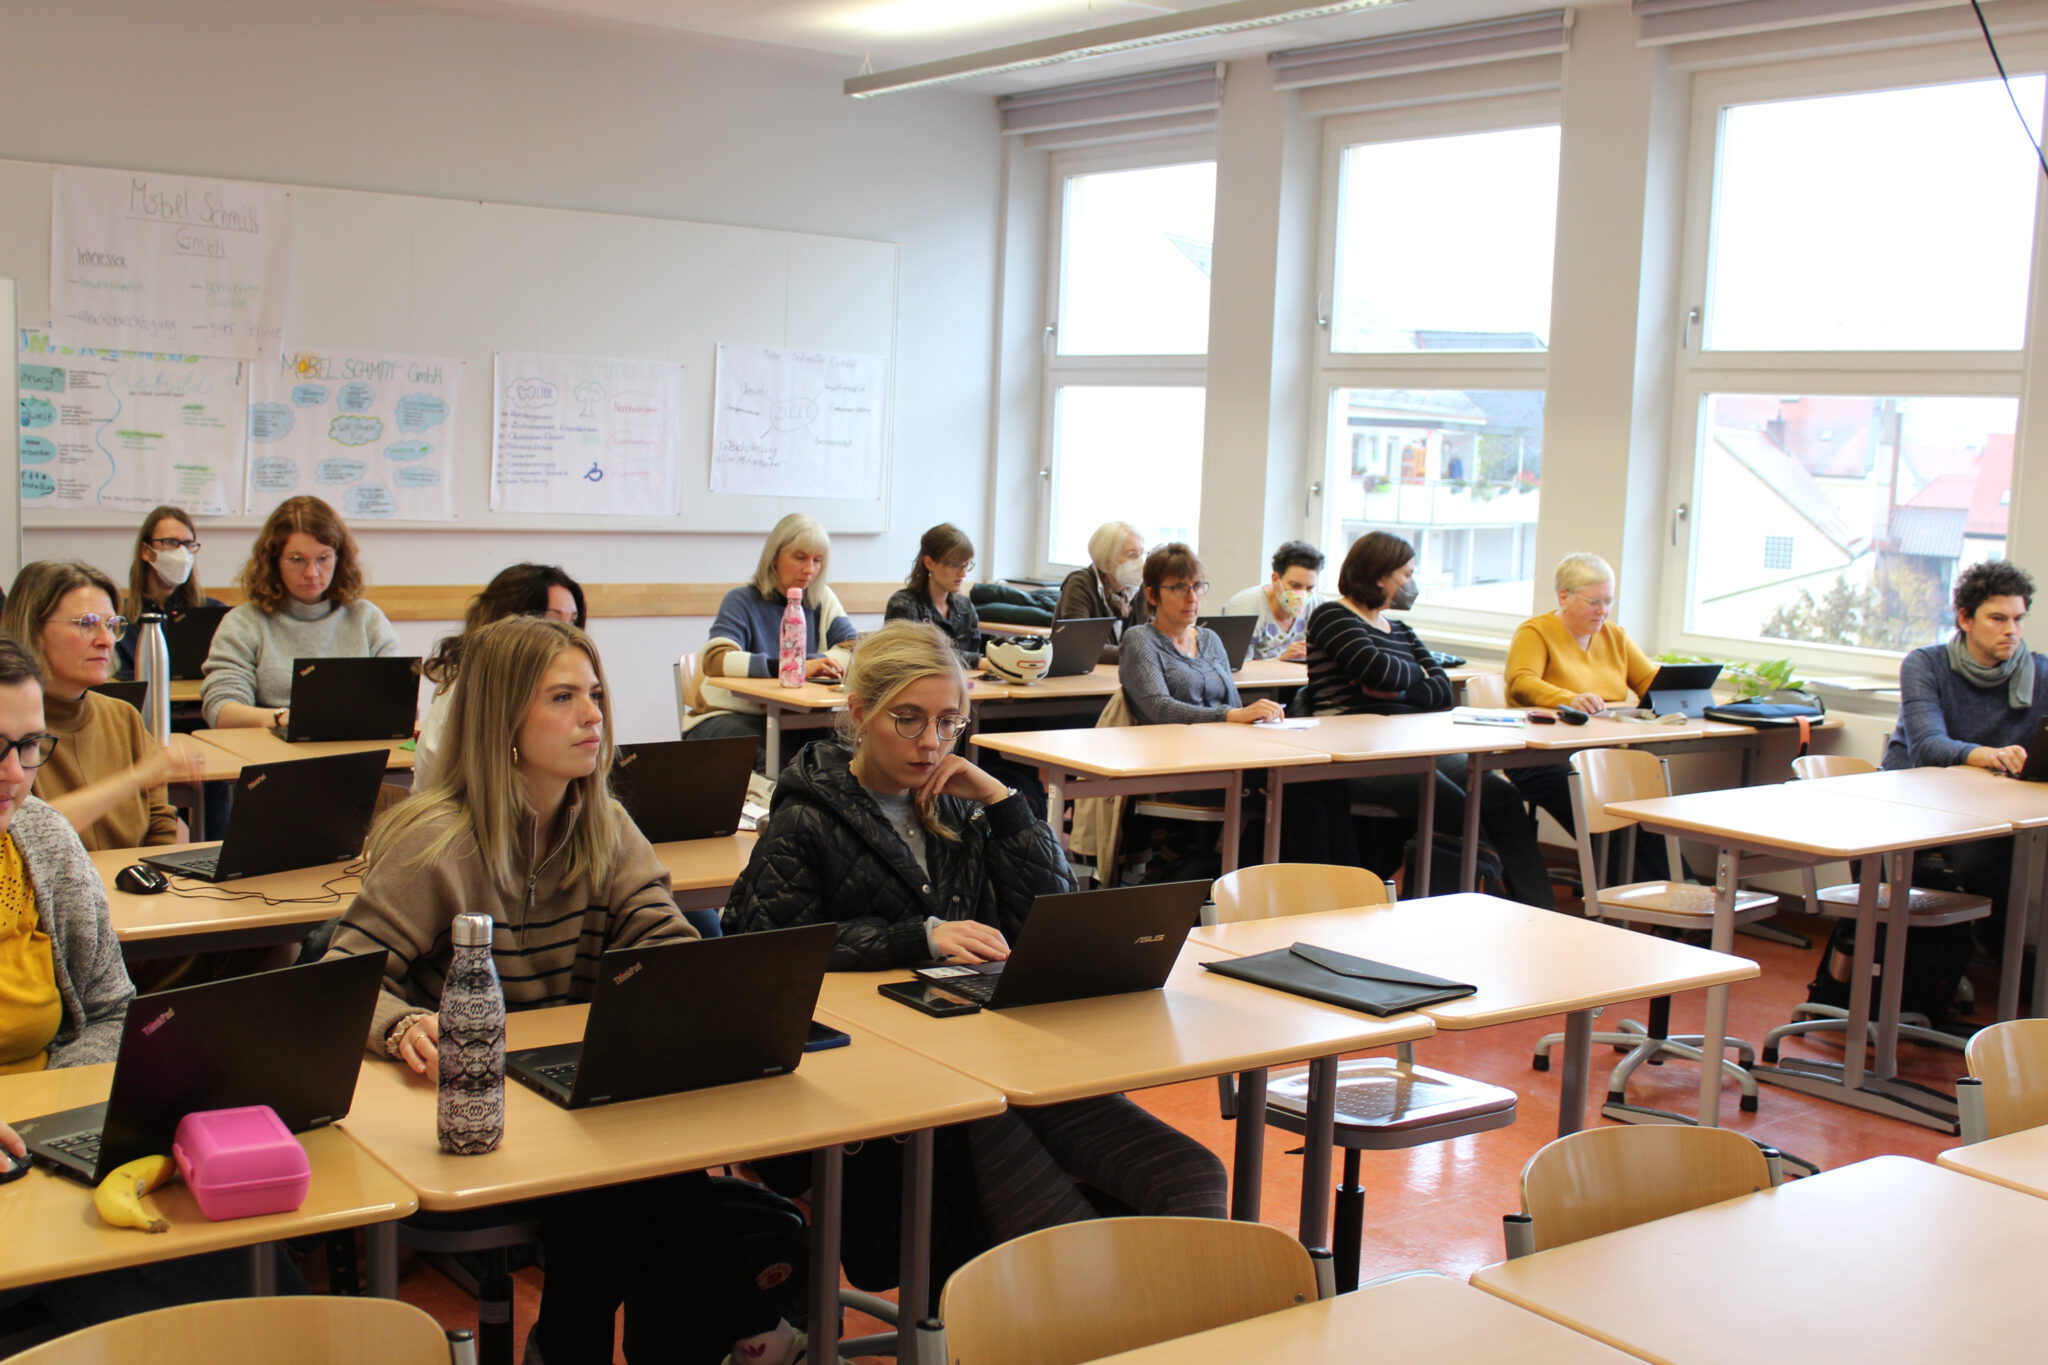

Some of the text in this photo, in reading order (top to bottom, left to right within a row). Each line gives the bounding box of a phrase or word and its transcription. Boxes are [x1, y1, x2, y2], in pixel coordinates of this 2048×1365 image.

[129, 177, 189, 219] Möbel
[1134, 934, 1166, 945] ASUS
[612, 961, 643, 985] ThinkPad
[141, 1006, 176, 1037] ThinkPad
